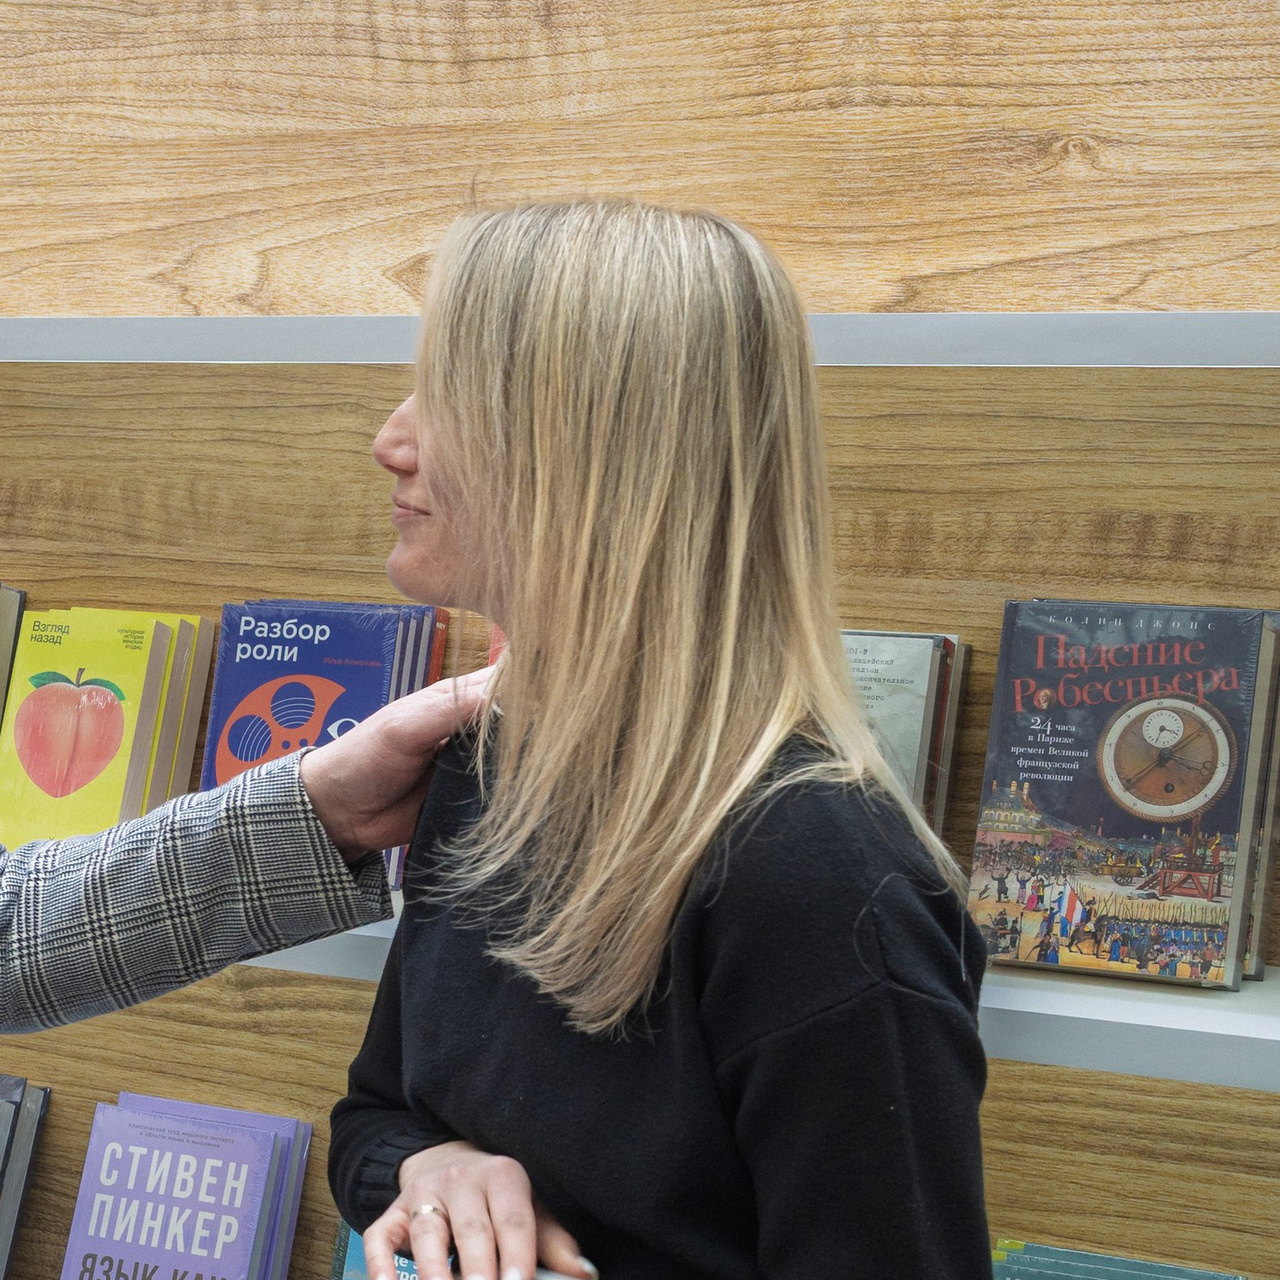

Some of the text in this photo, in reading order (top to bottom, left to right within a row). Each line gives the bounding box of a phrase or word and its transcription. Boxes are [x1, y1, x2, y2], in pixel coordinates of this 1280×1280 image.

[32, 620, 70, 636] Взгляд
[238, 616, 331, 644] Разбор
[29, 632, 63, 646] назад
[235, 641, 299, 663] роли
[1035, 633, 1207, 676] Падение
[1012, 664, 1243, 715] Робеспьера
[1029, 716, 1076, 736] 24 часа
[1037, 733, 1075, 745] Париже
[1010, 746, 1089, 758] времен Великой
[1016, 757, 1080, 770] французской
[1019, 771, 1074, 782] революции
[99, 1141, 250, 1209] СТИВЕН
[87, 1192, 240, 1260] ПИНКЕР
